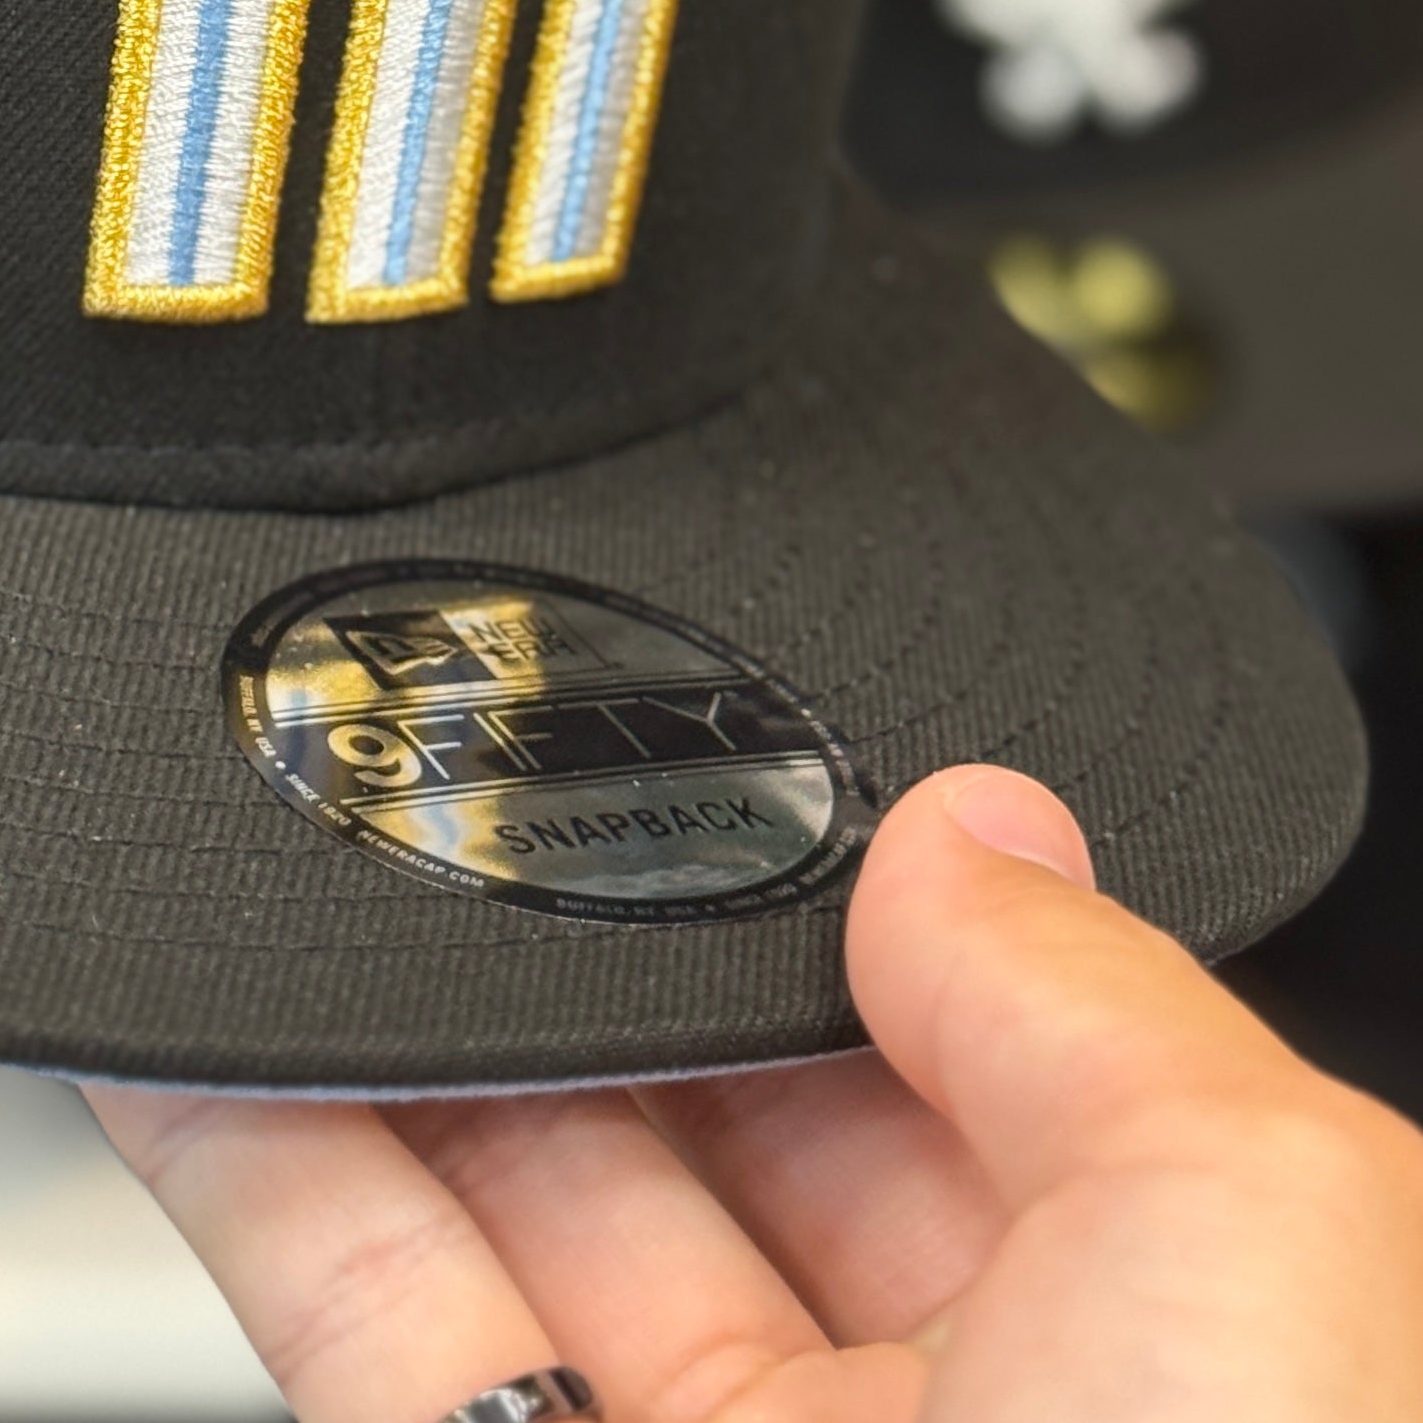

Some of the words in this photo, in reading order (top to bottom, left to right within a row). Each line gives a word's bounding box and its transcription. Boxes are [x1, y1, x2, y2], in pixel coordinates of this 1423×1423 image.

[468, 617, 557, 644] NEW
[484, 637, 576, 665] ERA
[327, 691, 738, 788] 9FIFTY
[494, 798, 773, 855] SNAPBACK
